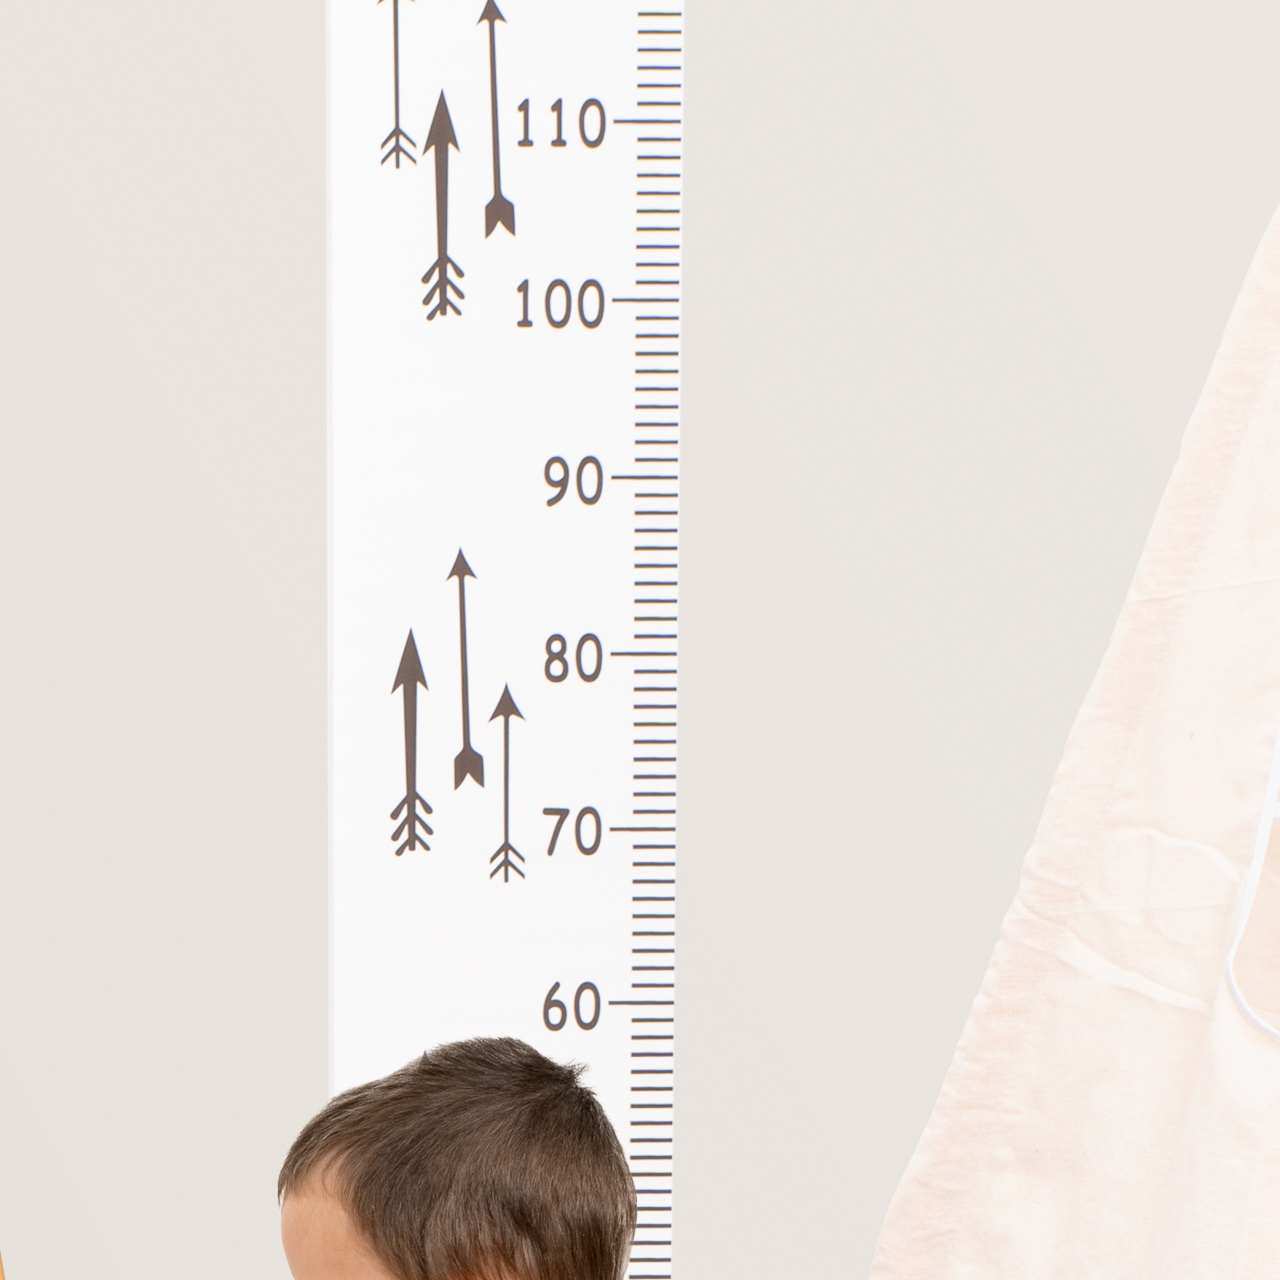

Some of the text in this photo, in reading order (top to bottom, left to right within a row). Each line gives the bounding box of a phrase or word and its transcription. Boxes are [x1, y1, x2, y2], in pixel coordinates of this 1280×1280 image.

[516, 97, 607, 150] 110
[516, 278, 606, 329] 100
[544, 455, 603, 507] 90
[544, 632, 603, 683] 80
[542, 806, 602, 856] 70
[542, 980, 601, 1031] 60
